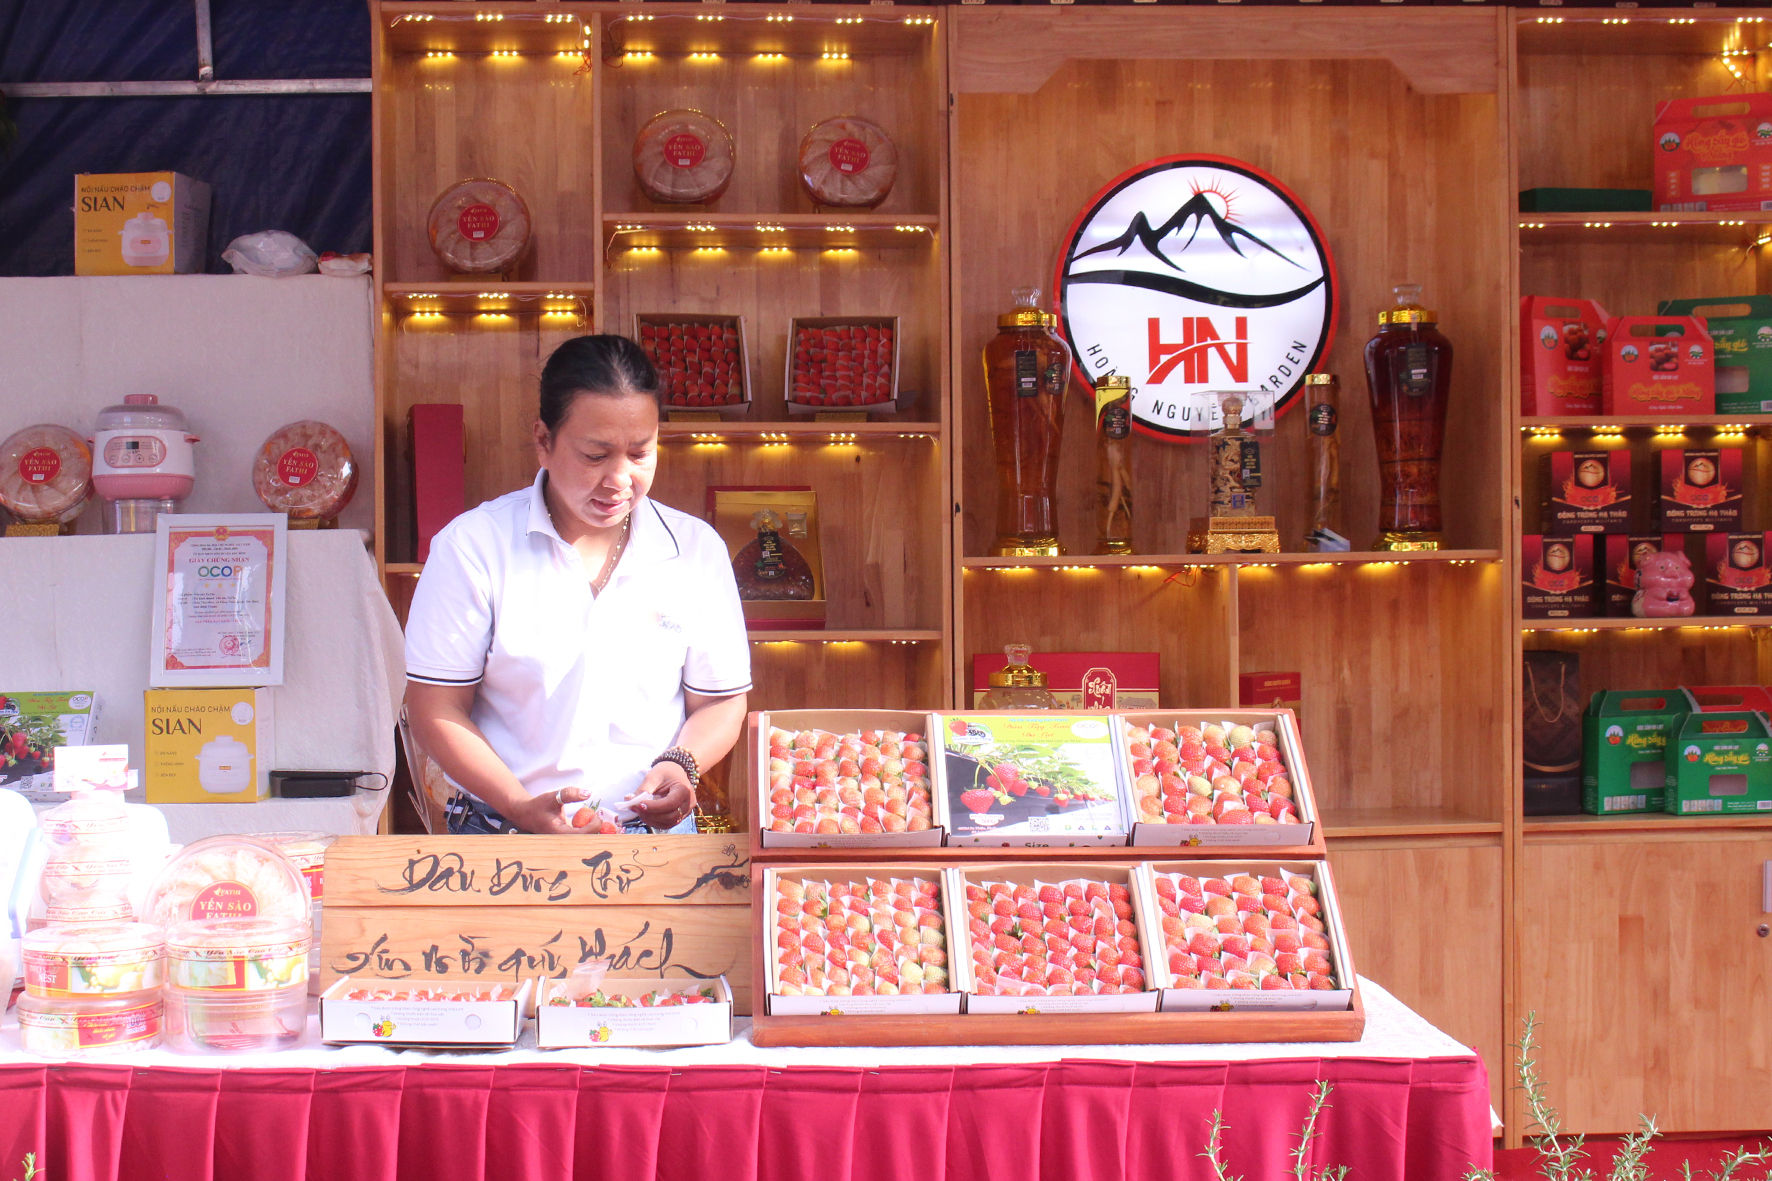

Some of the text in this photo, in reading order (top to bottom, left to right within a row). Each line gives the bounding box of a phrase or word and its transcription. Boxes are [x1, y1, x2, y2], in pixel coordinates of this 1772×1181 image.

[81, 195, 125, 213] SIAN
[1146, 316, 1251, 384] HN
[1087, 344, 1139, 401] HOÀG
[1152, 400, 1224, 422] NGUYÊ
[1250, 340, 1308, 405] ARDEN
[283, 456, 297, 466] YẾN
[285, 466, 308, 474] FATHI
[198, 565, 243, 577] OCOP
[166, 704, 182, 713] NẤU
[151, 717, 202, 735] SIAN
[199, 898, 252, 911] YẾN SÀO
